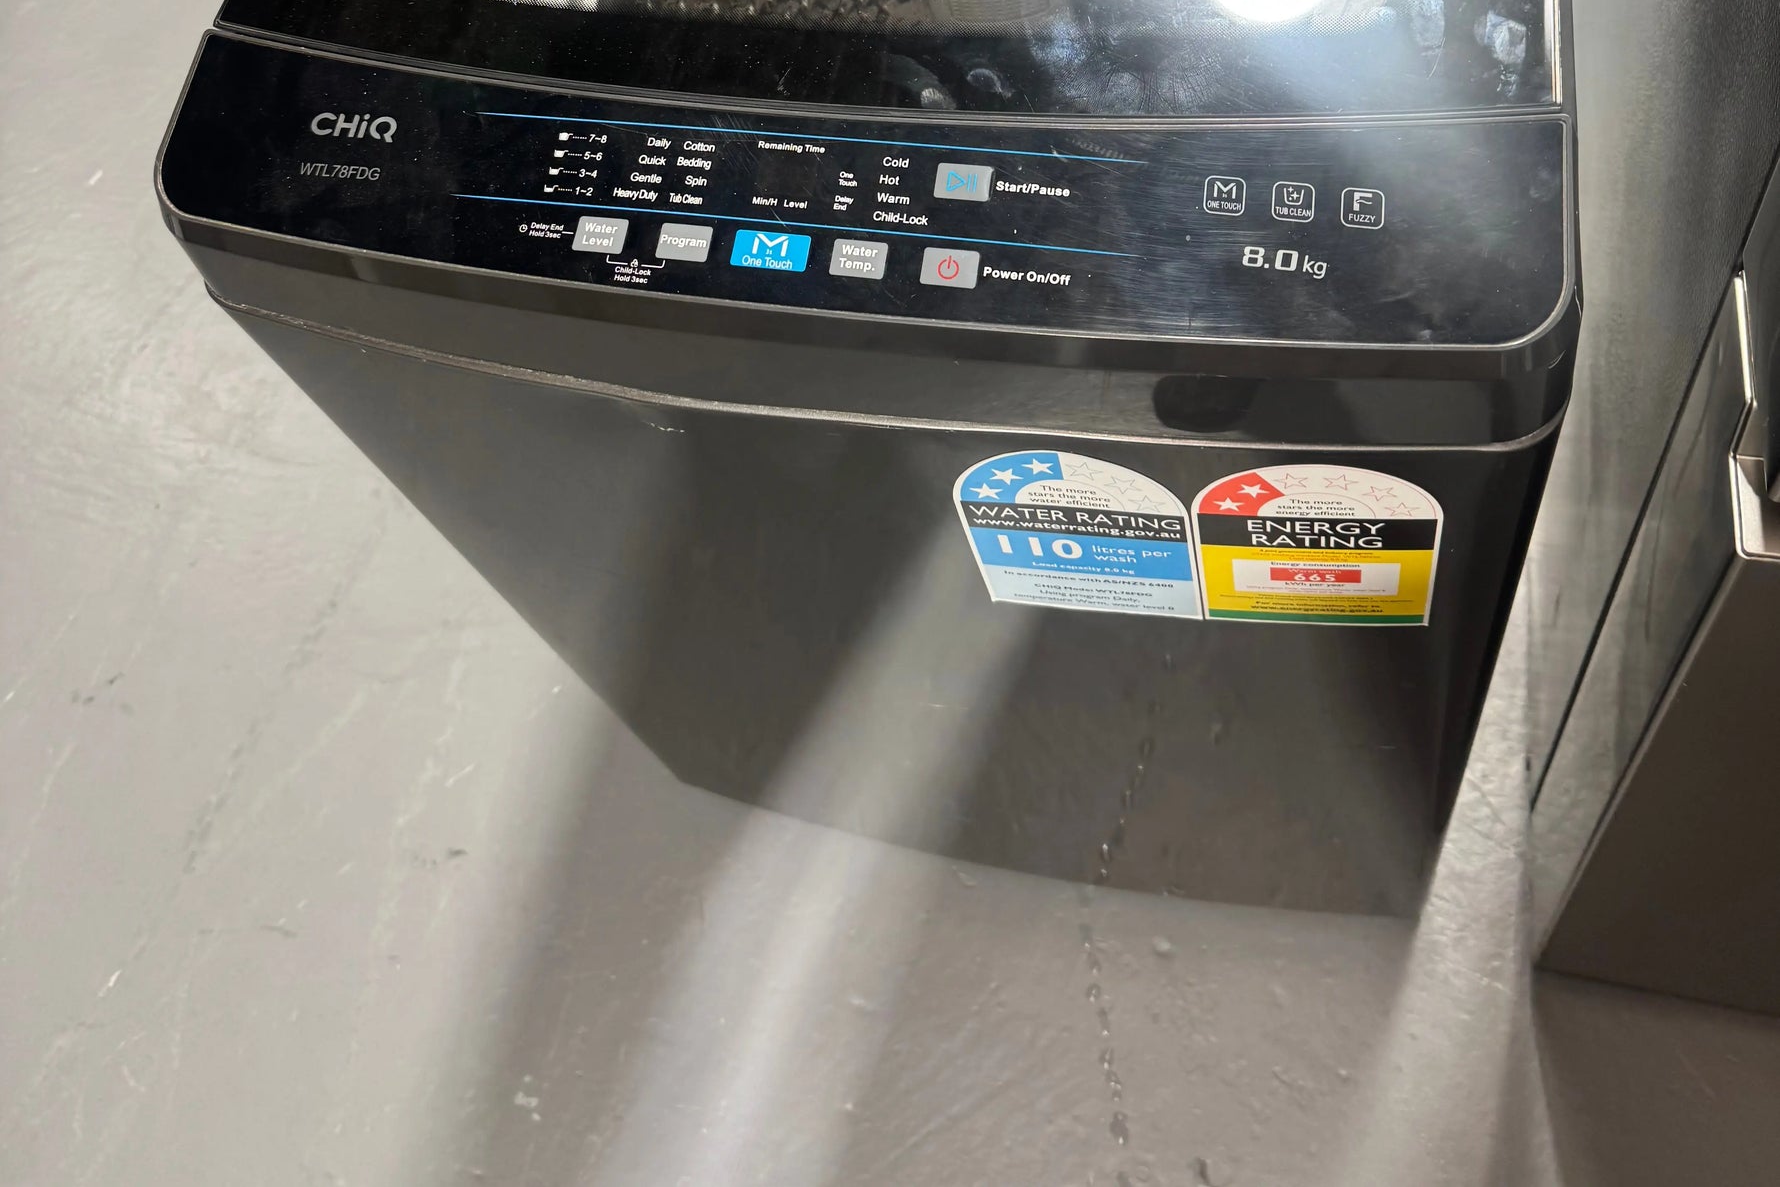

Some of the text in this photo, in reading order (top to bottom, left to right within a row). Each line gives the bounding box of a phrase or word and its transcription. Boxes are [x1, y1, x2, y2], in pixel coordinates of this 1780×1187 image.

[647, 137, 716, 152] Daily Cotton
[758, 140, 826, 154] Remaining Time
[638, 154, 712, 171] Quick Bedding
[882, 156, 910, 168] Cold
[300, 162, 381, 180] WTL78FDG
[839, 171, 854, 179] One
[630, 172, 708, 187] Gentle Spin
[838, 178, 858, 188] Touch
[879, 174, 900, 186] Hot
[613, 188, 658, 202] Heavy Duty
[996, 180, 1070, 197] Start/Pause
[668, 192, 703, 205] Tub Clean
[752, 196, 778, 206] Min/H
[784, 199, 808, 210] Level
[834, 195, 854, 204] Delay
[877, 192, 910, 205] Warm
[1206, 200, 1242, 210] ONE TOUCH
[833, 202, 848, 211] End
[1275, 206, 1312, 217] TUB CLEAN
[872, 210, 929, 226] Child-Lock
[1348, 214, 1376, 223] FUZZY
[530, 222, 550, 230] Delay
[584, 222, 618, 234] Water
[528, 230, 545, 238] Hold
[582, 234, 614, 247] Level
[660, 234, 708, 248] Program
[842, 244, 878, 258] Water
[742, 254, 792, 270] One Touch
[839, 258, 876, 272] Temp.
[1242, 246, 1328, 279] 8.0 kg
[614, 266, 652, 276] Child-Lock
[983, 266, 1071, 286] Power On/Off
[614, 274, 648, 284] Hold 3sec
[1040, 484, 1062, 492] The
[1066, 500, 1110, 508] efficient
[968, 504, 1181, 531] WATER RATING
[973, 517, 1181, 540] www.waterrating.gov.au
[1246, 519, 1386, 535] ENERGY
[997, 534, 1083, 560] 110
[1251, 534, 1383, 548] RATING
[1092, 544, 1172, 559] litres per
[1094, 554, 1137, 564] wash
[1060, 565, 1102, 573] capacity
[1016, 572, 1076, 582] accordance
[1103, 578, 1146, 587] AS/NZS
[1294, 574, 1336, 582] 665
[1040, 590, 1066, 598] Using
[1070, 593, 1110, 601] program
